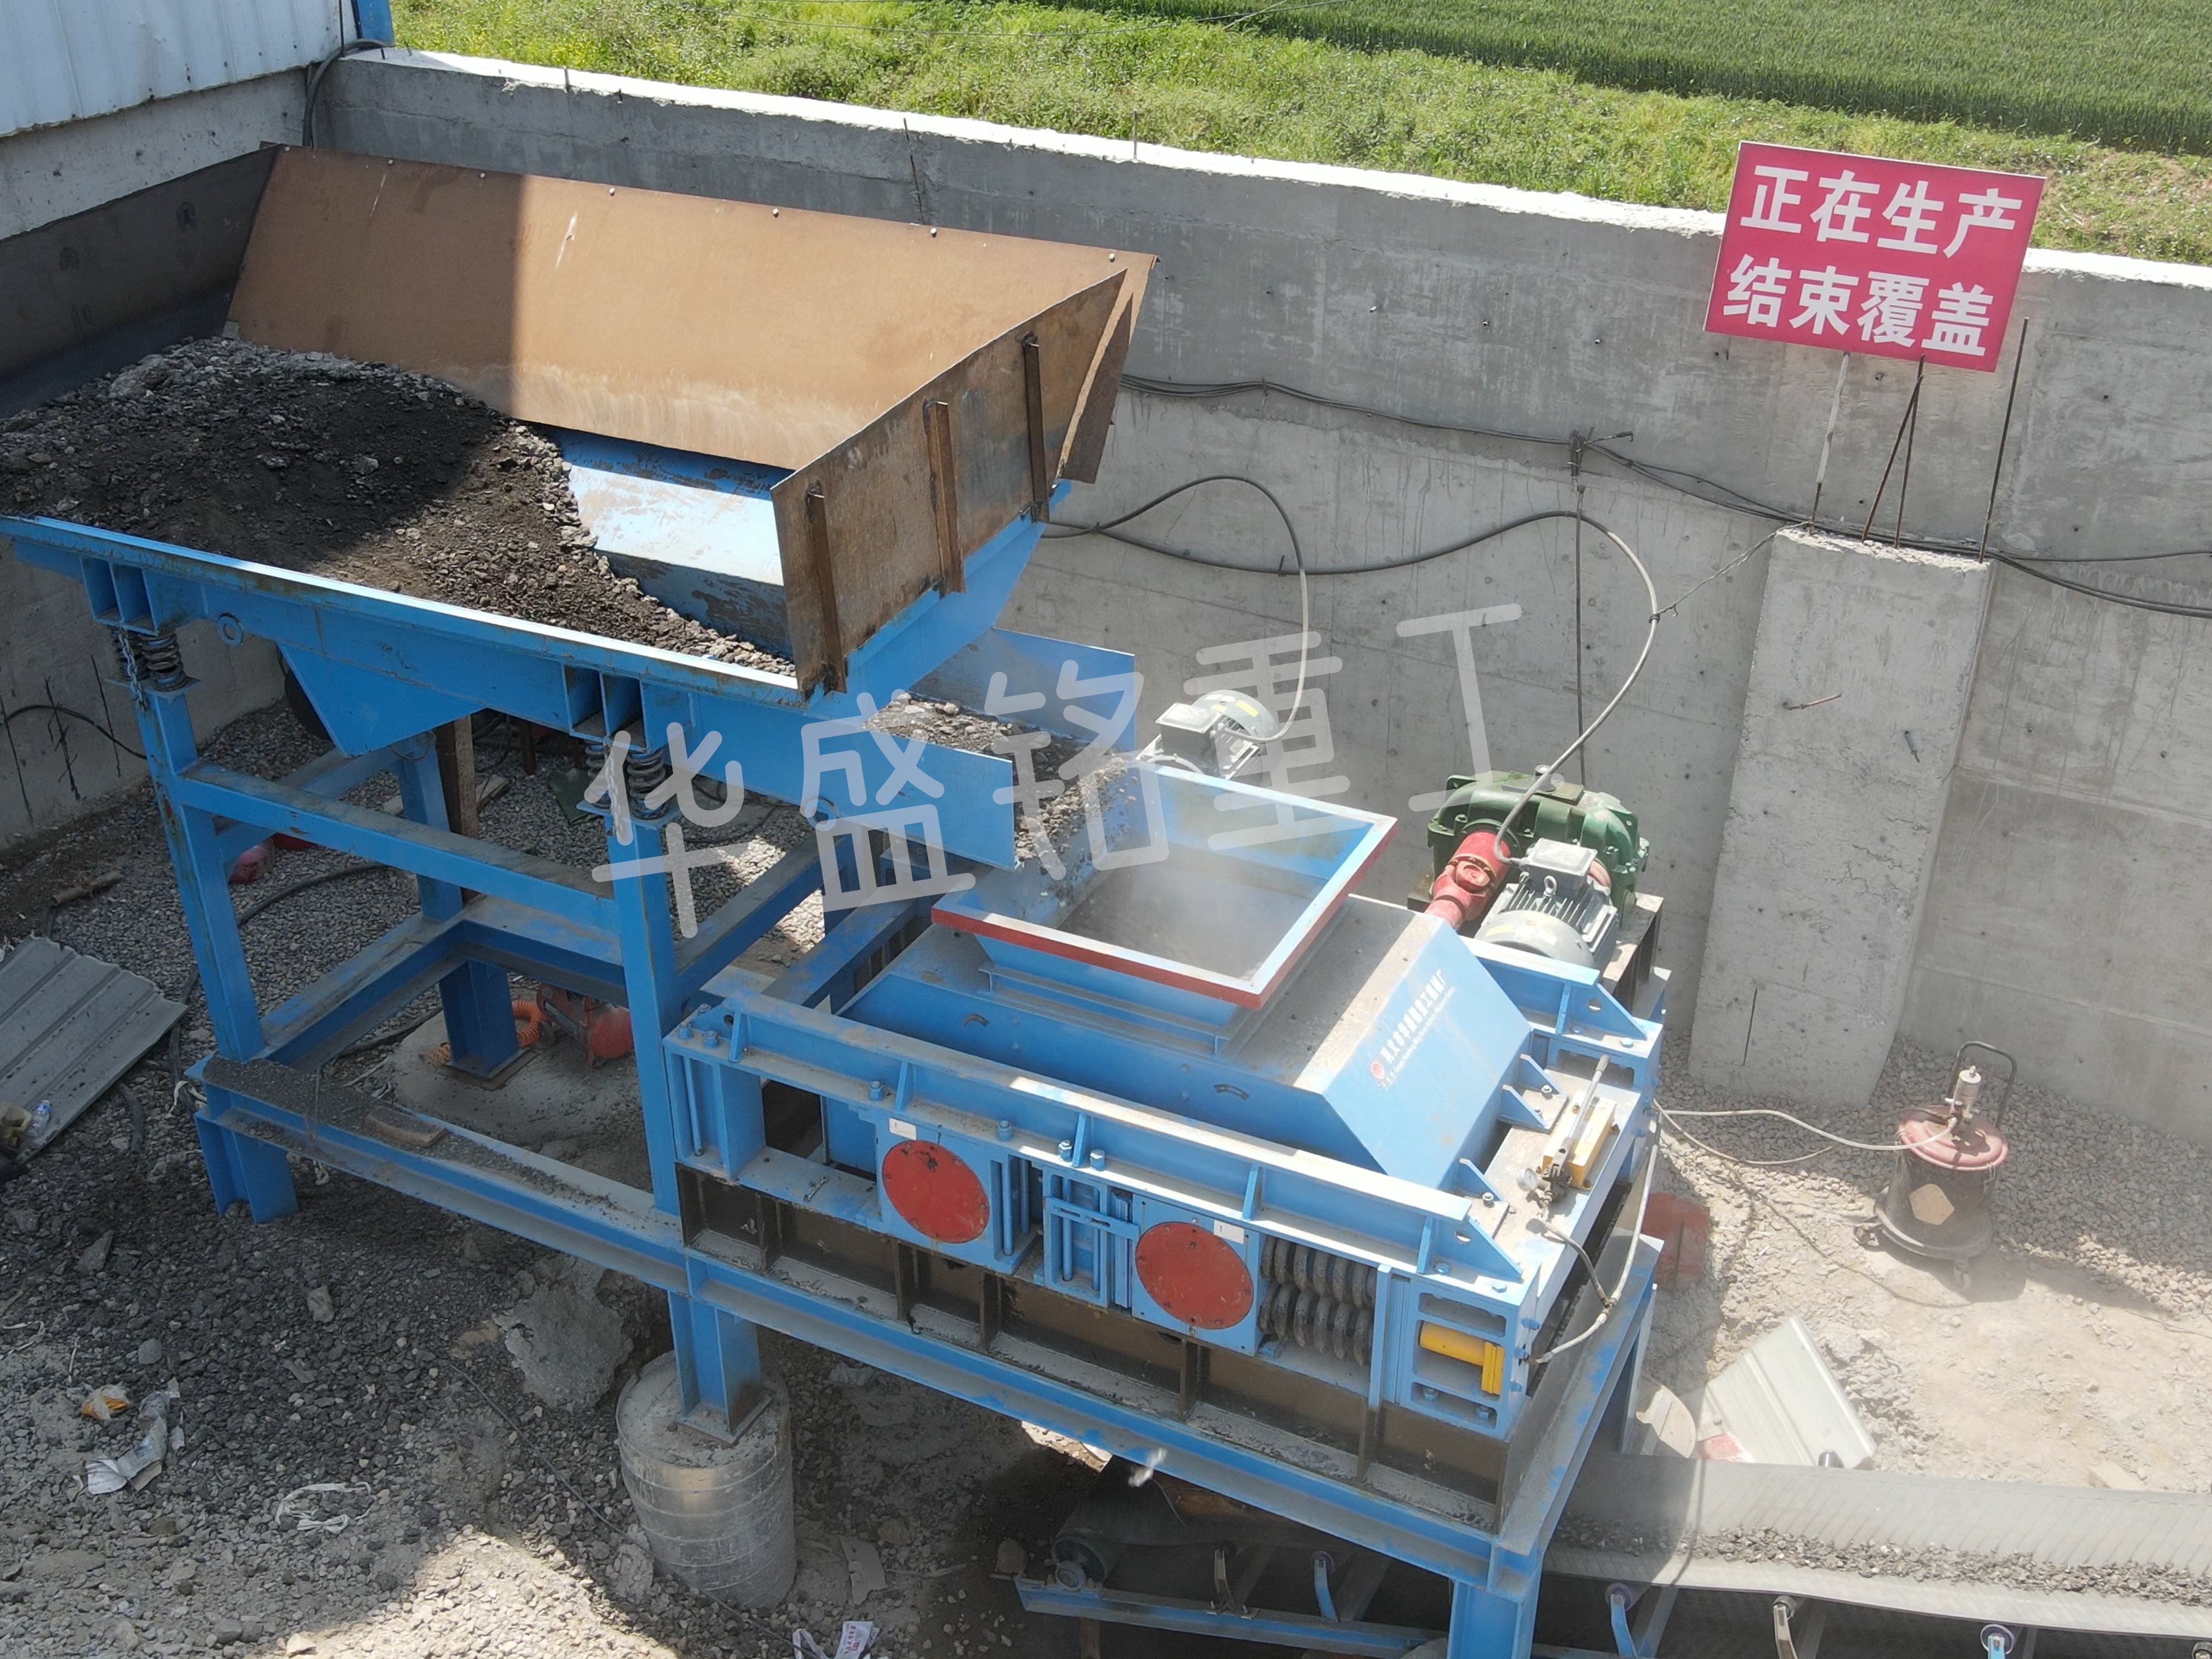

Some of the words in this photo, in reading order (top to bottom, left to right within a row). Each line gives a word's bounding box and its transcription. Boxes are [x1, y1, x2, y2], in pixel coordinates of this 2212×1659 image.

[1740, 165, 2023, 258] 正在生产
[1723, 254, 1994, 357] 结束覆盖
